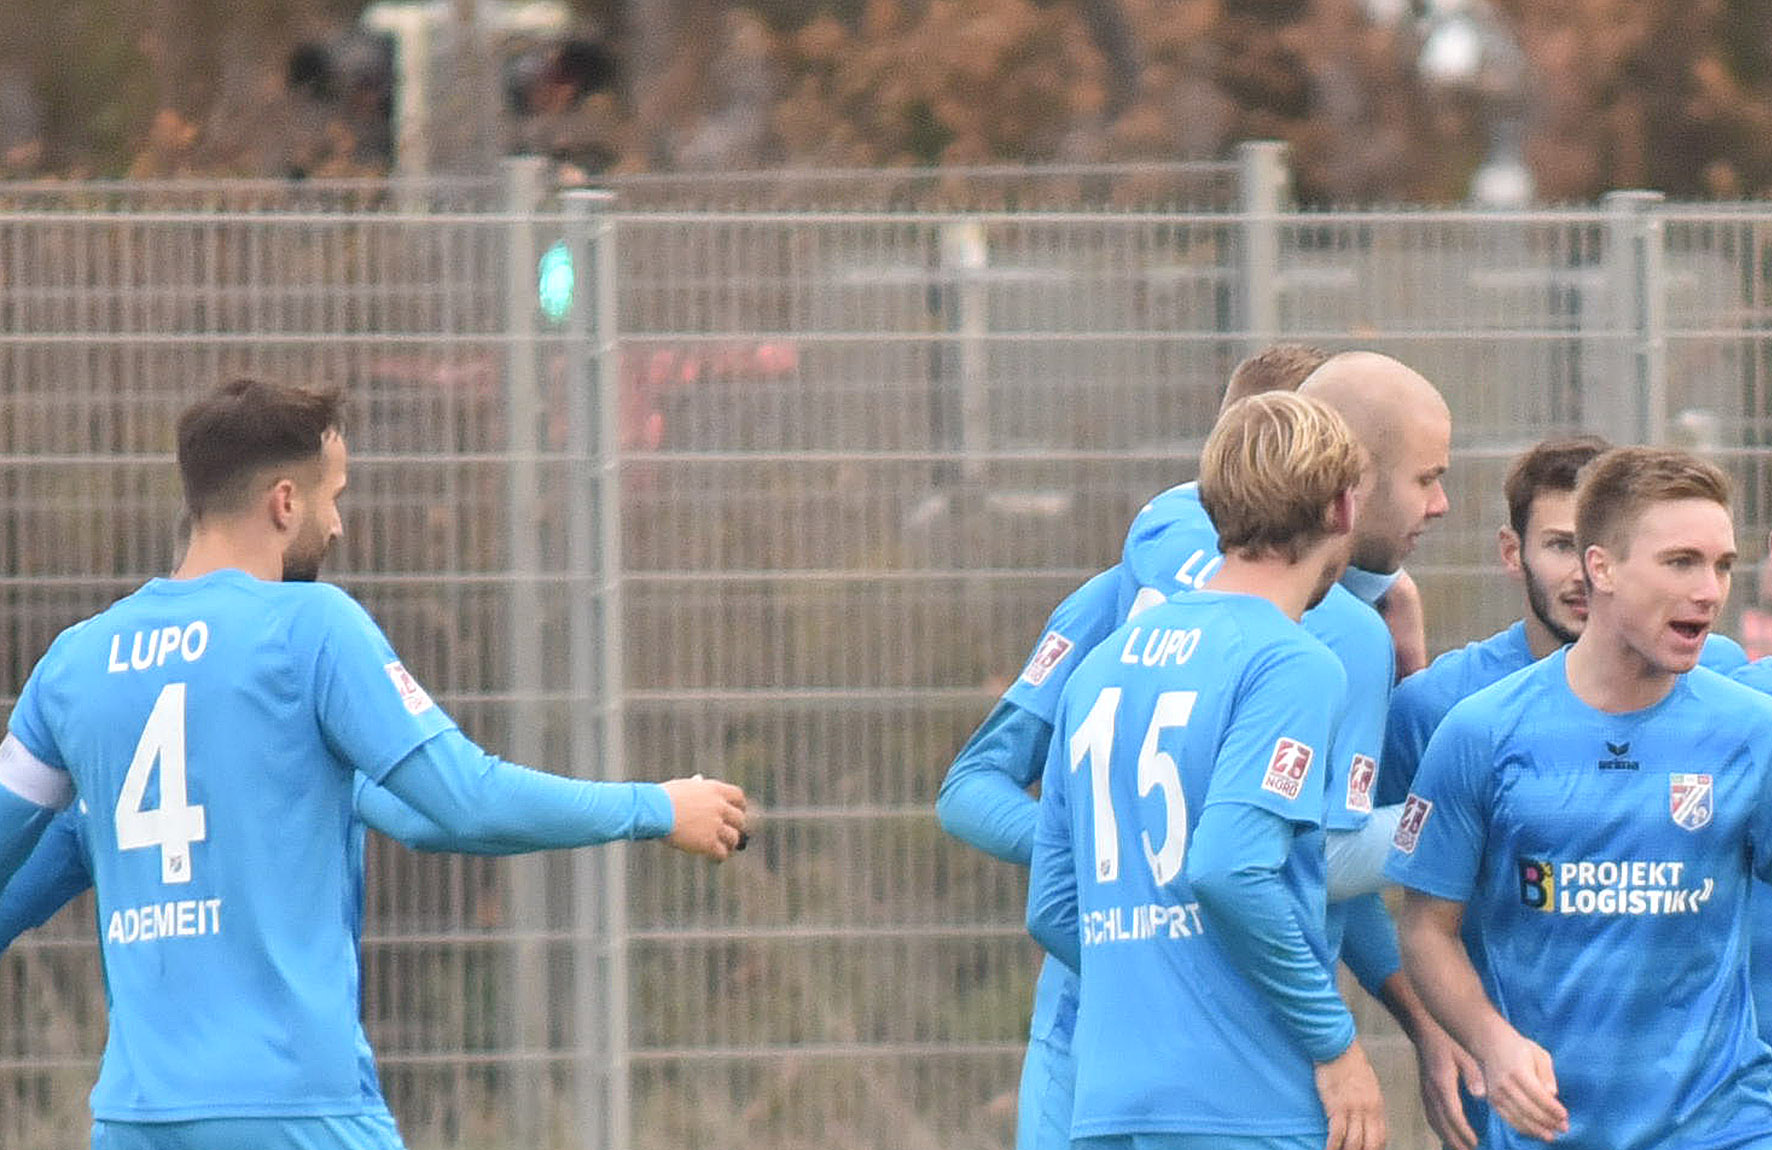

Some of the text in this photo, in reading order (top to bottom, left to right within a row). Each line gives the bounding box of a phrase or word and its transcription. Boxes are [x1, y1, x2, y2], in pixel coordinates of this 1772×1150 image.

[108, 620, 209, 673] LUPO
[1120, 626, 1202, 667] LUPO
[115, 682, 207, 884] 4
[1069, 687, 1198, 887] 15
[1265, 776, 1299, 797] NORD
[1560, 861, 1684, 888] PROJEKT
[108, 899, 222, 944] ADEMEIT
